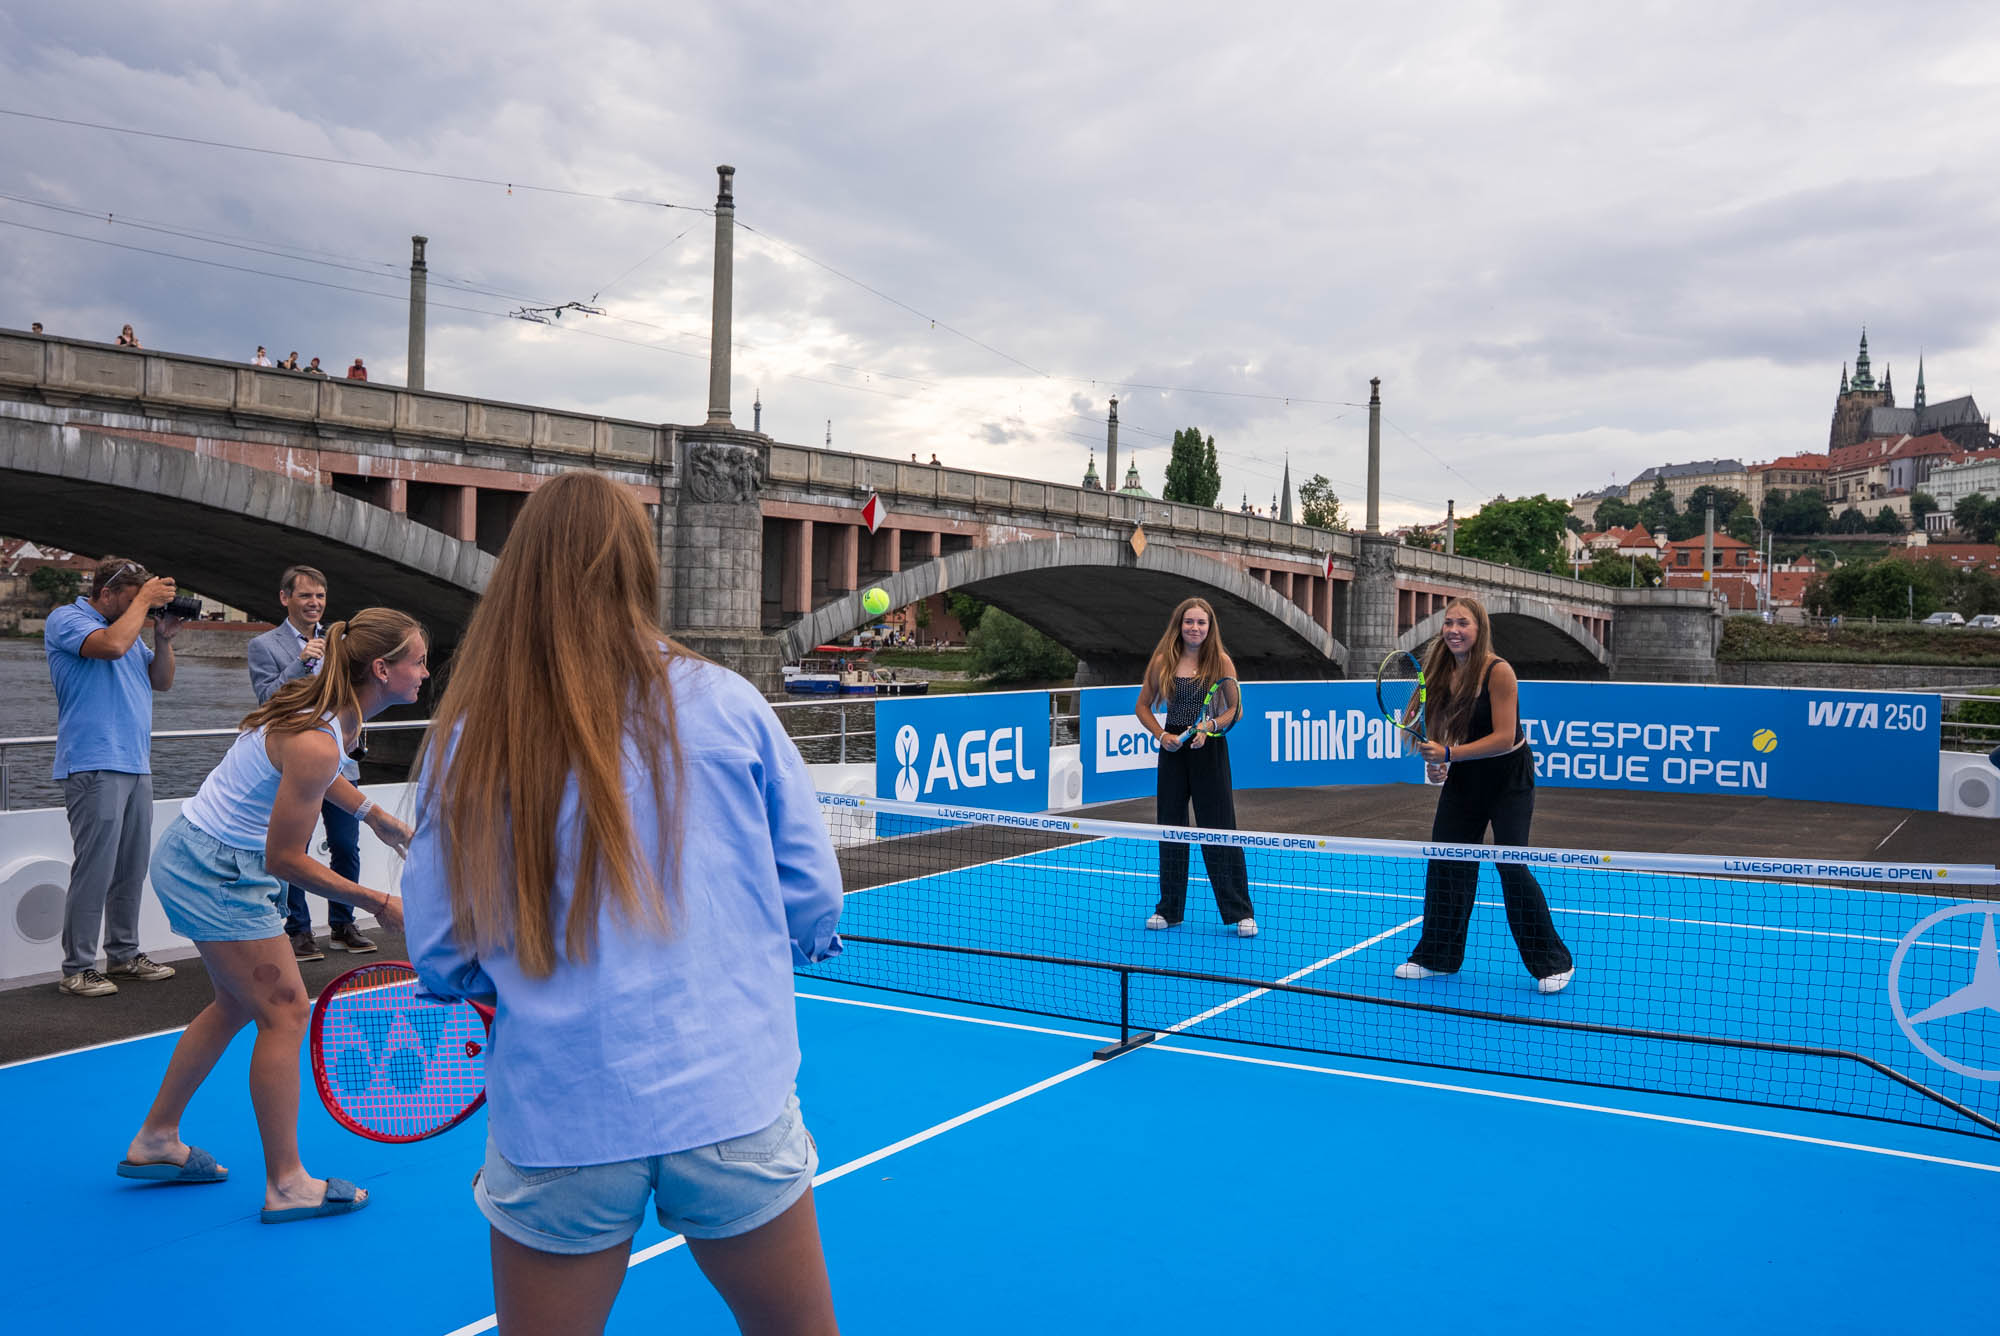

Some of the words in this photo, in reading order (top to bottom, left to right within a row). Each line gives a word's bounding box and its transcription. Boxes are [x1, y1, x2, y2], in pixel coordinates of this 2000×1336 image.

[1808, 701, 1879, 729] WTA
[1885, 703, 1926, 731] 250
[1105, 728, 1160, 757] Len
[1265, 708, 1402, 762] ThinkPad
[1519, 718, 1720, 752] IVESPORT
[923, 726, 1036, 794] AGEL
[1532, 751, 1650, 783] RAGUE
[1662, 757, 1768, 789] OPEN
[833, 796, 858, 808] OPEN
[937, 807, 996, 823] LIVESPORT
[997, 814, 1039, 828] PRAGUE
[1041, 819, 1071, 831] OPEN
[1162, 829, 1229, 844] LIVESPORT
[1231, 834, 1280, 848] PRAGUE
[1282, 838, 1316, 849] OPEN
[1422, 846, 1499, 860] LIVESPORT
[1502, 850, 1558, 863] PRAGUE
[1561, 853, 1599, 865] OPEN
[1724, 860, 1812, 876] LIVESPORT
[1817, 864, 1883, 879] PRAGUE
[1887, 867, 1933, 880] OPEN
